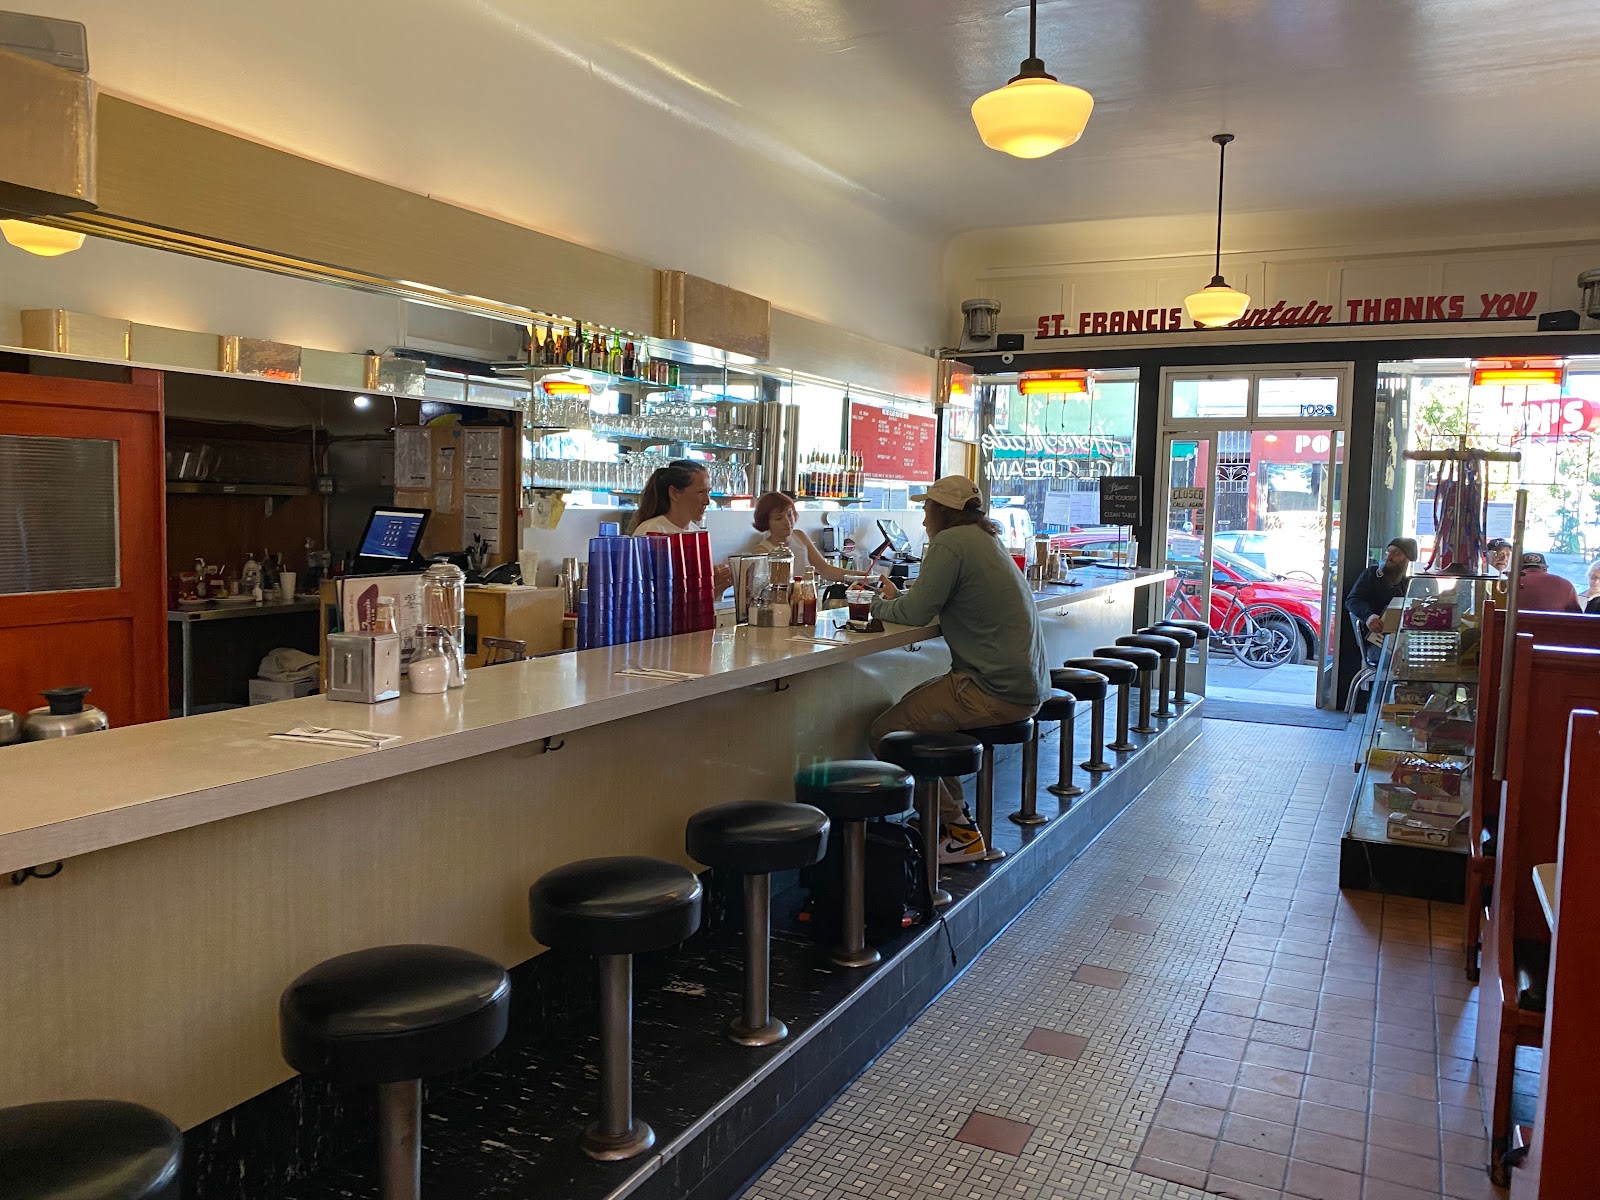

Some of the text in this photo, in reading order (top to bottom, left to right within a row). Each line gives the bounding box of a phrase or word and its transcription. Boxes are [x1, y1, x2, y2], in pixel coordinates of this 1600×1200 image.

[1037, 314, 1069, 337] ST.
[1079, 308, 1182, 335] FRANCIS
[1346, 295, 1465, 323] THANKS
[1480, 291, 1538, 319] YOU
[1173, 489, 1204, 501] CLOSED
